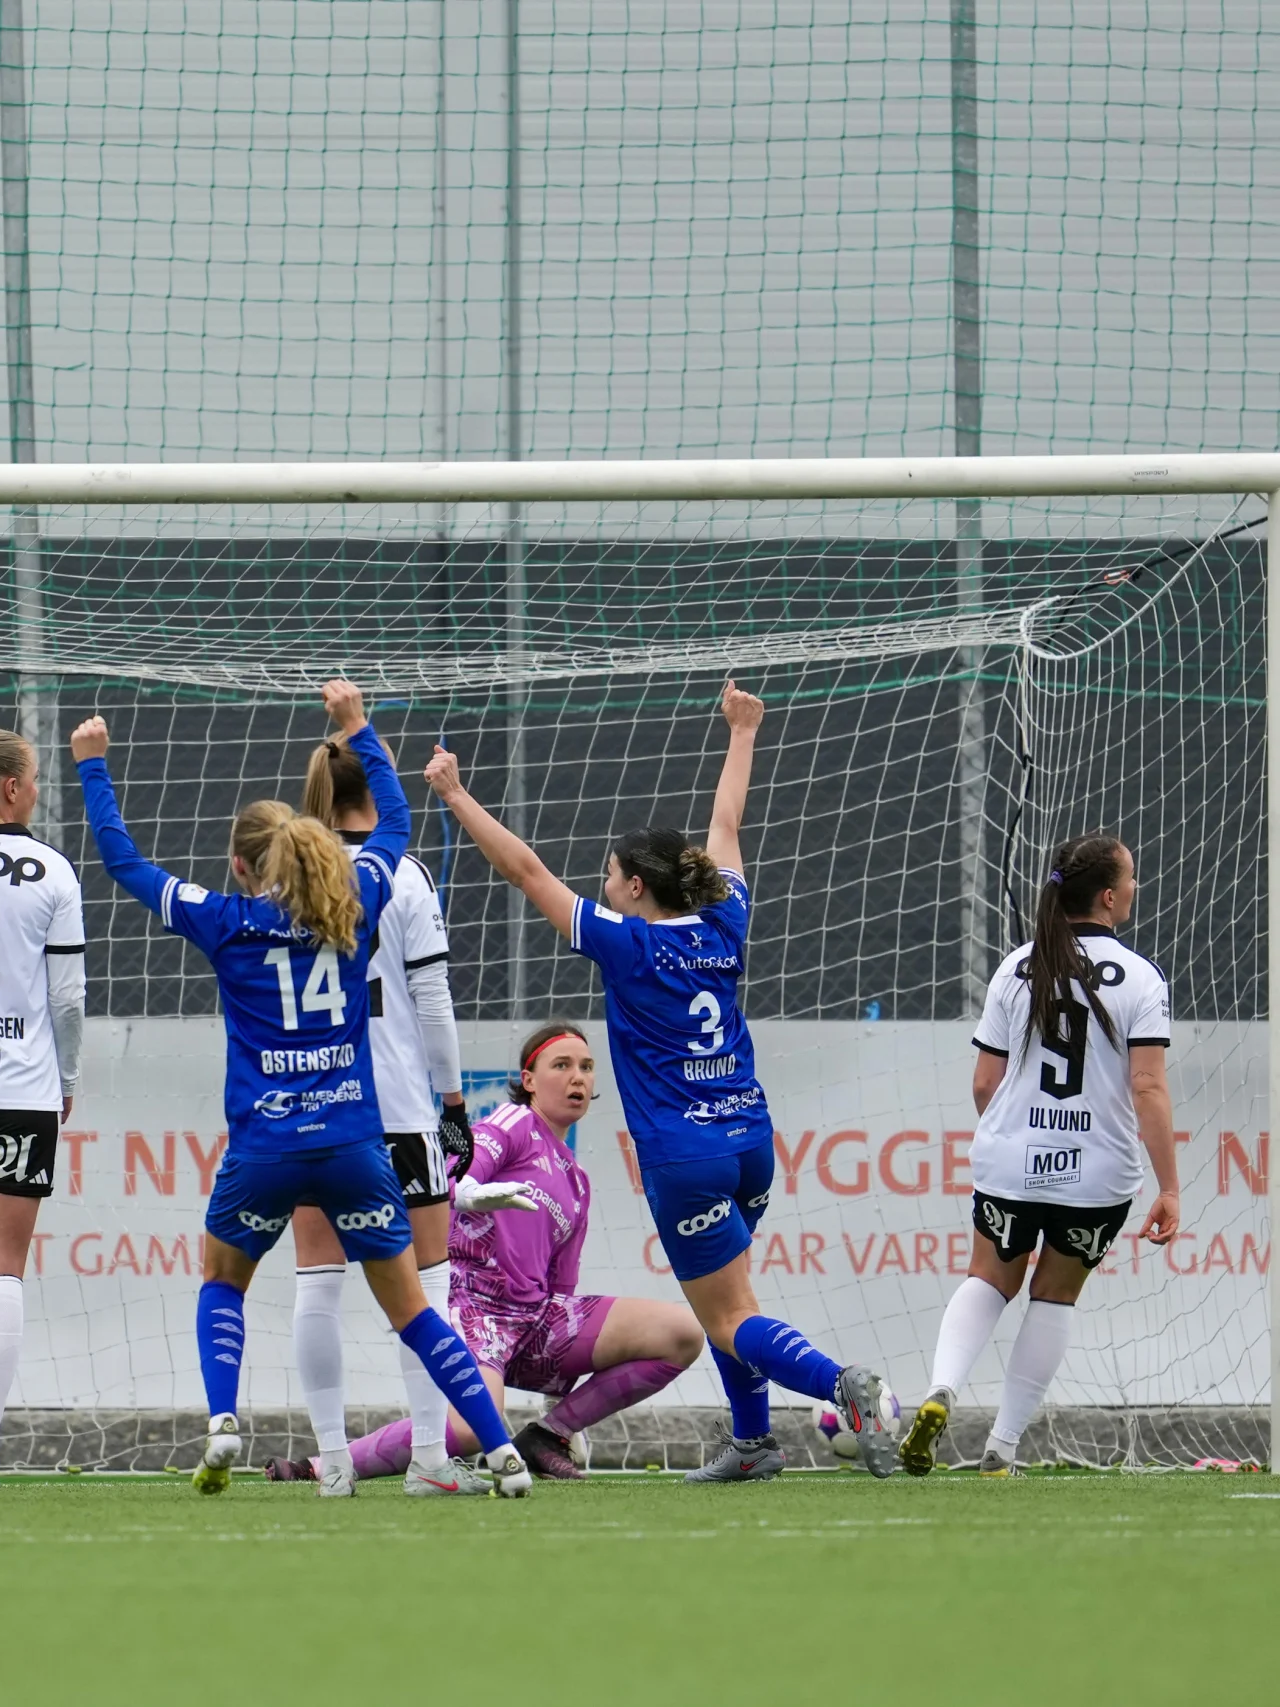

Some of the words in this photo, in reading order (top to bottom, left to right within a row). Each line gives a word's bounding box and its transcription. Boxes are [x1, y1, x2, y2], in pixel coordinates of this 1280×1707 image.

[263, 945, 347, 1031] 14
[687, 991, 724, 1056] 3
[1040, 999, 1090, 1101] 9
[297, 1122, 326, 1133] umbro
[726, 1127, 748, 1137] umbro
[1028, 1107, 1091, 1132] ULVUND
[1033, 1148, 1082, 1175] MOT
[336, 1203, 396, 1231] coop
[842, 1234, 969, 1276] VARE
